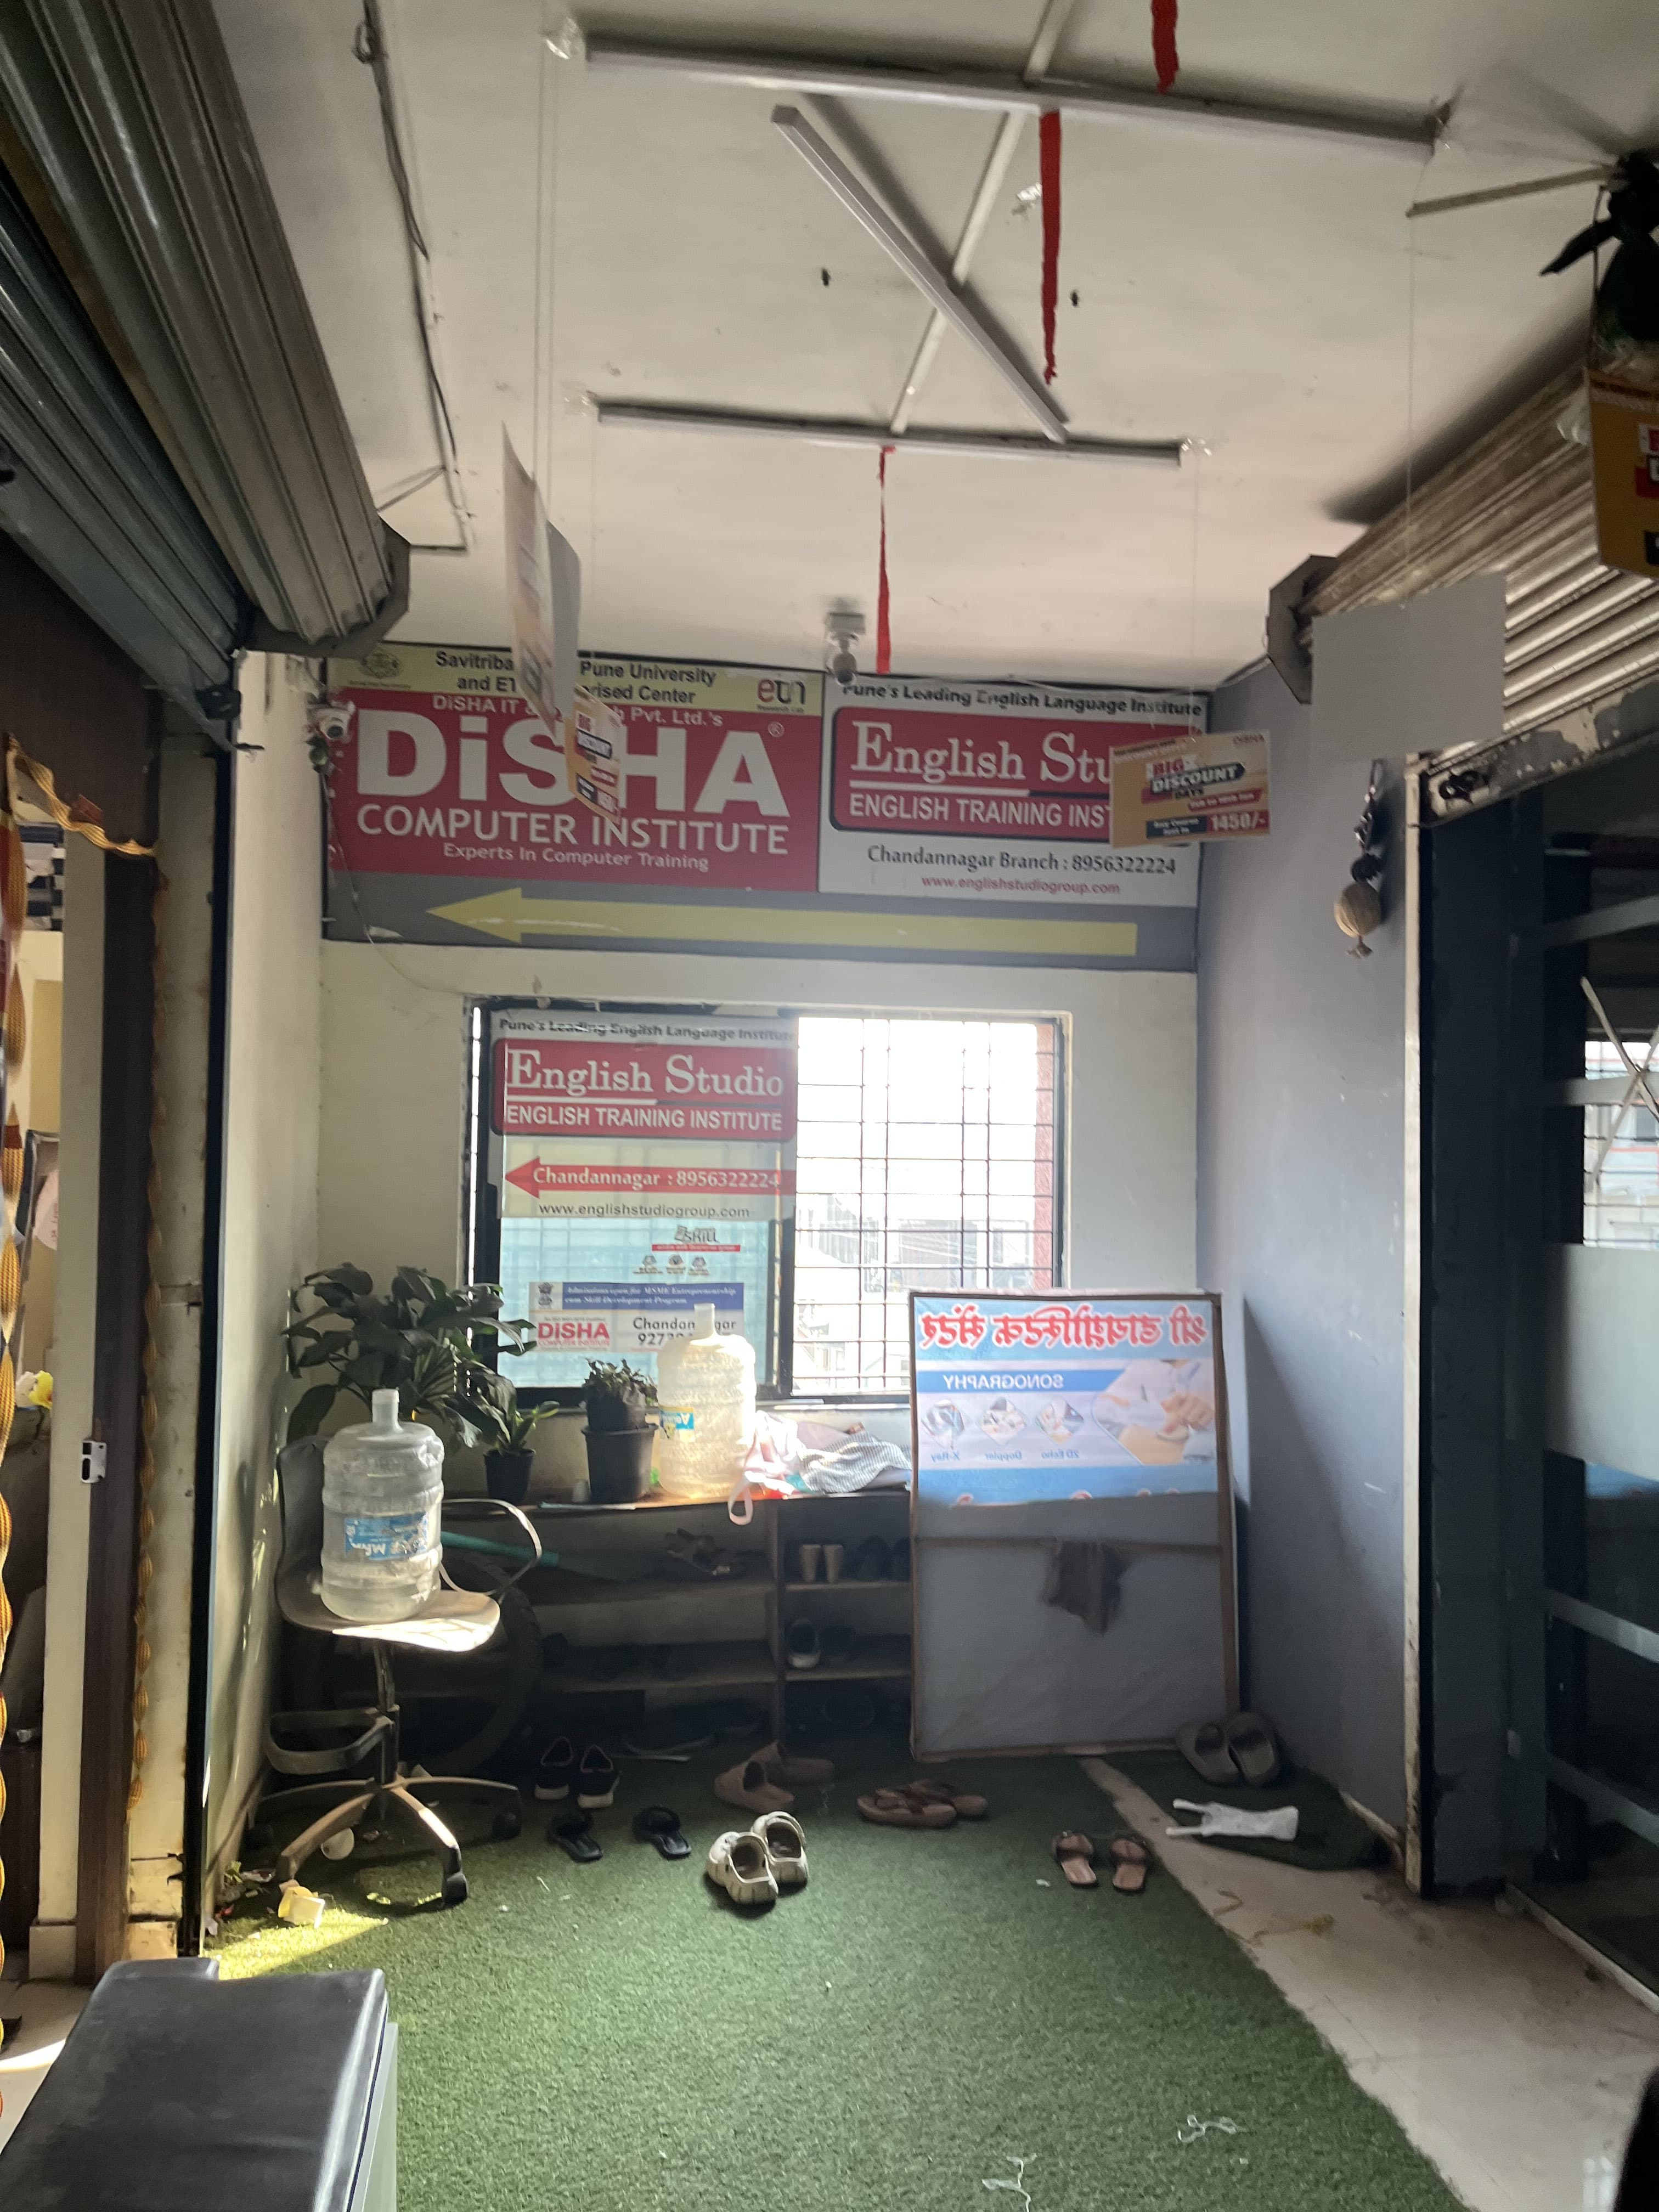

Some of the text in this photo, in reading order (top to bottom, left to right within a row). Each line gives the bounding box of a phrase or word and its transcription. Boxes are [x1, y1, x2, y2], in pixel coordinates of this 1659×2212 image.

[436, 650, 716, 687] Savitriba Pune University
[456, 675, 490, 691] and
[639, 685, 696, 704] Center
[903, 686, 972, 707] Leading
[976, 689, 1040, 710] English
[1043, 693, 1128, 715] Language
[1131, 697, 1203, 716] Institute
[501, 698, 520, 714] IT
[631, 706, 667, 723] Pvt.
[850, 720, 1026, 785] English
[1152, 766, 1237, 794] DISCOUNT
[850, 793, 950, 821] ENGLISH
[956, 798, 1063, 827] TRAINING
[357, 803, 790, 855] COMPUTER INSTITUTE
[443, 842, 709, 873] Experts In Computer Training
[867, 843, 996, 873] Chandannagar
[999, 851, 1059, 871] Branch
[1072, 854, 1177, 875] 8956322224
[921, 877, 1121, 895] www.englishstudiogroup.com
[499, 1018, 546, 1031] Pune's
[610, 1022, 662, 1038] English
[666, 1025, 735, 1041] Language
[507, 1048, 784, 1097] English Studio
[506, 1105, 783, 1131] ENGLISH TRAINING INSTITUTE
[533, 1166, 661, 1191] Chandannagar
[676, 1170, 778, 1189] 8956322224
[539, 1203, 750, 1218] www.englishstudiogroup.com
[633, 1317, 737, 1330] Chandangar
